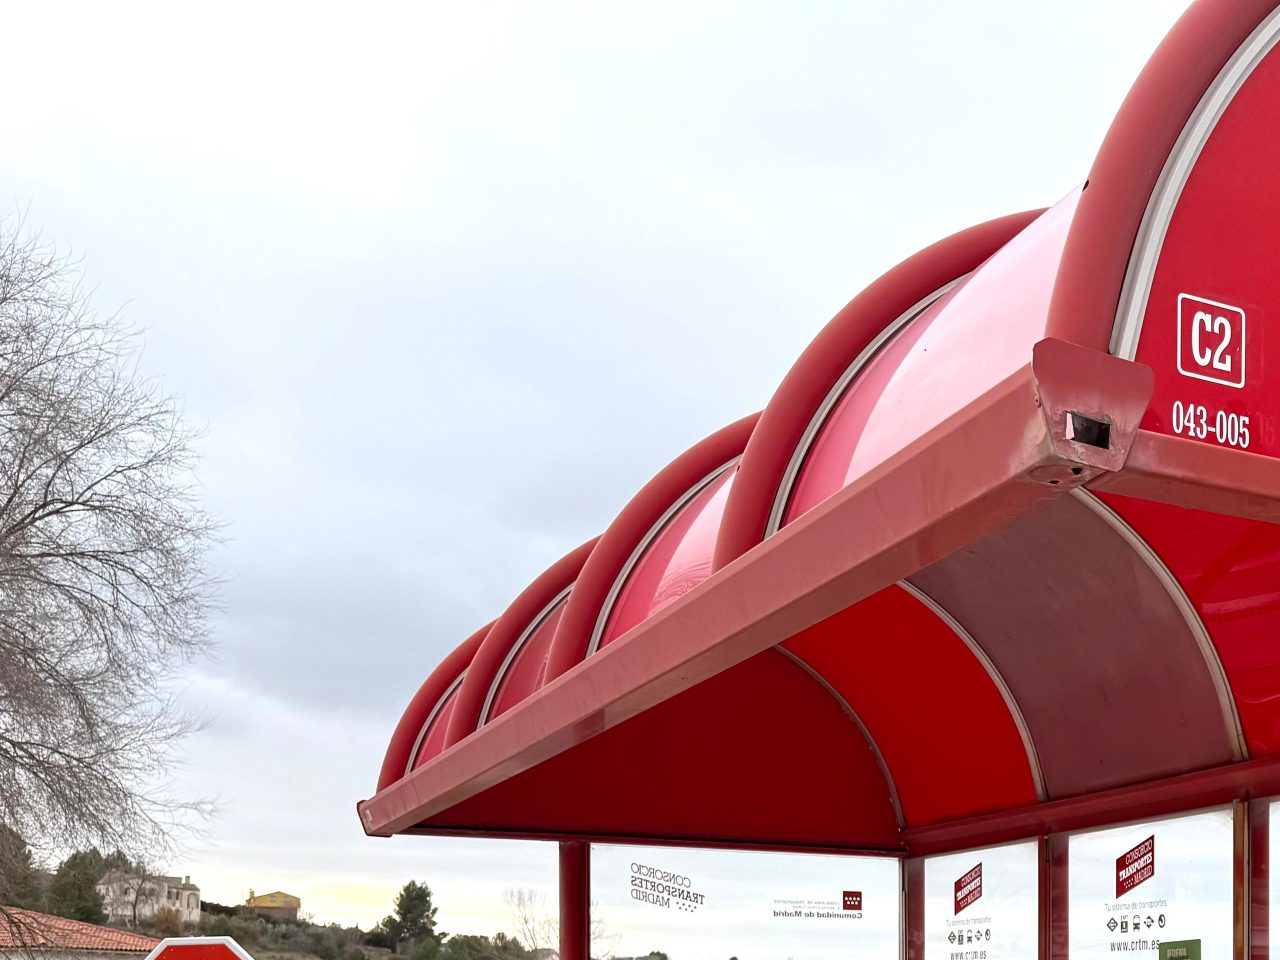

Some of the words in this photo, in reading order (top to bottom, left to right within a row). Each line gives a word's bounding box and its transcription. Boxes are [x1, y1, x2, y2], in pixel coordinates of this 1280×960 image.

[1191, 310, 1233, 372] C2
[1172, 400, 1250, 449] 043-005
[1125, 839, 1153, 865] CONSORCIO
[1119, 851, 1153, 882] TRANSPORTES
[1133, 864, 1153, 884] MADRID
[1112, 902, 1131, 911] sistema
[1131, 901, 1138, 909] de
[1138, 899, 1168, 909] transportes
[950, 950, 987, 960] www.crtm.es
[1110, 939, 1160, 952] www.crtm.es
